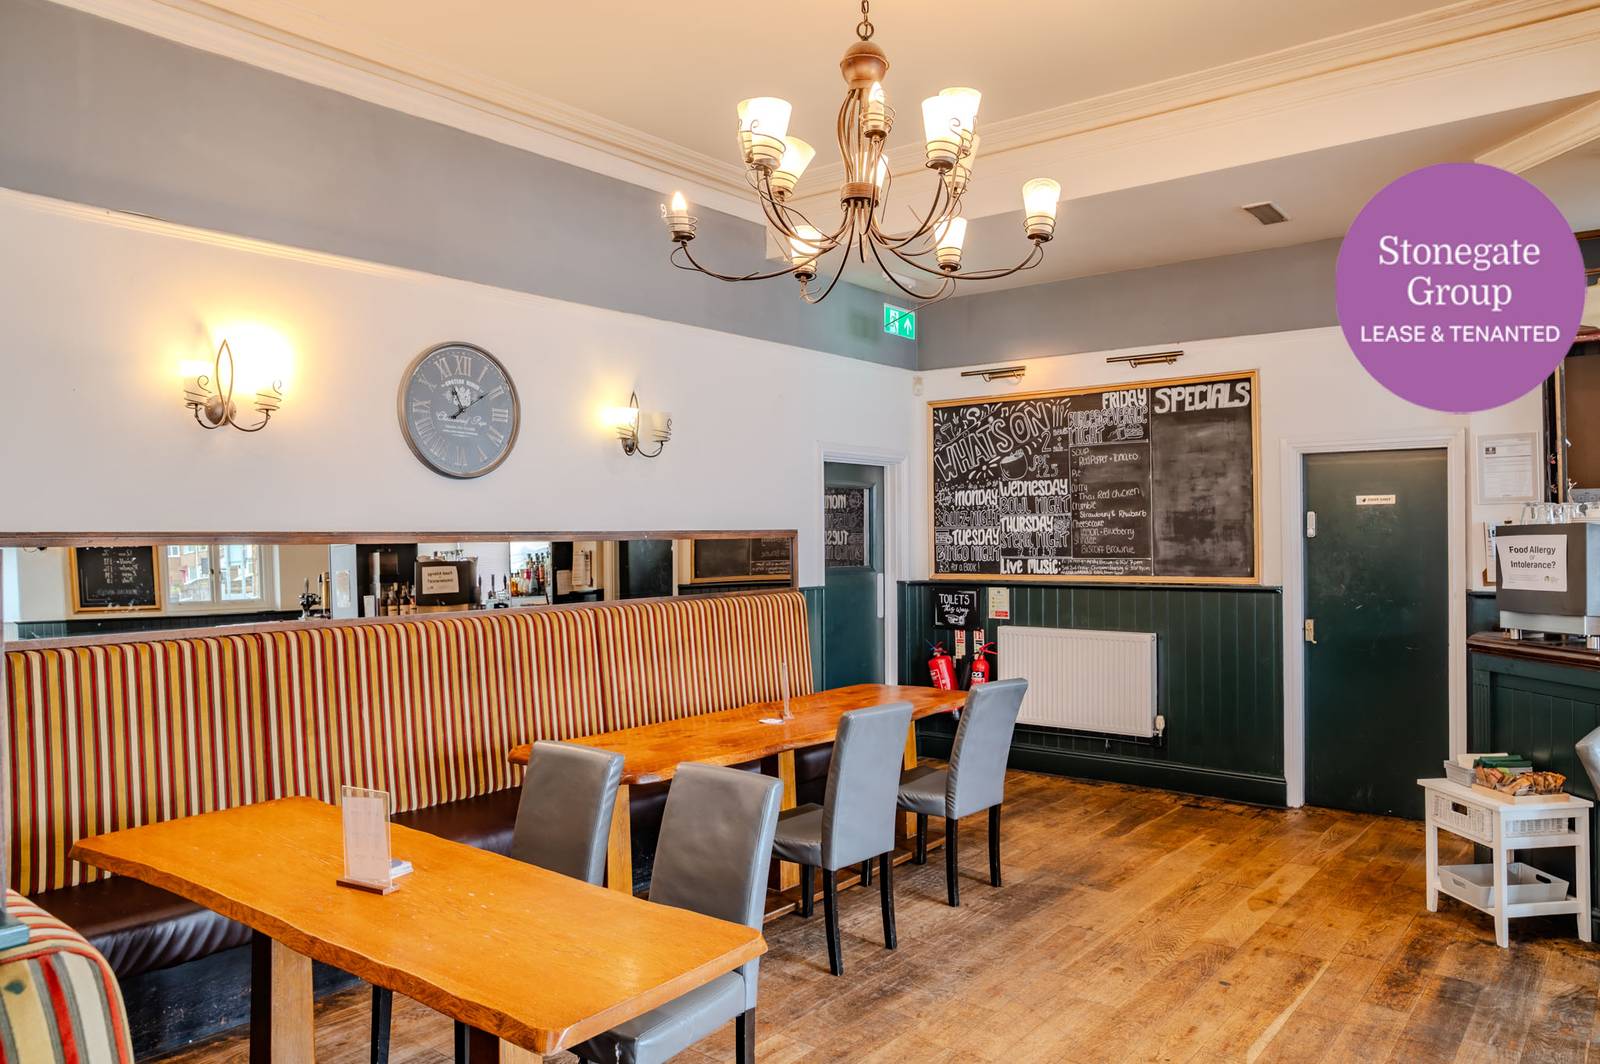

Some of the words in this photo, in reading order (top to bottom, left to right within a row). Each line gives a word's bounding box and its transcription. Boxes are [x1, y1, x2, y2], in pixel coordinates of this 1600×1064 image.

[1103, 388, 1147, 410] FRIDAY
[1154, 382, 1250, 414] SPECIALS
[1097, 489, 1110, 500] Red
[1000, 515, 1054, 533] THURSDAY
[1509, 546, 1528, 554] Food
[1530, 546, 1556, 555] Allergy
[1510, 560, 1556, 569] Intolerance?
[939, 593, 970, 605] TOILETS
